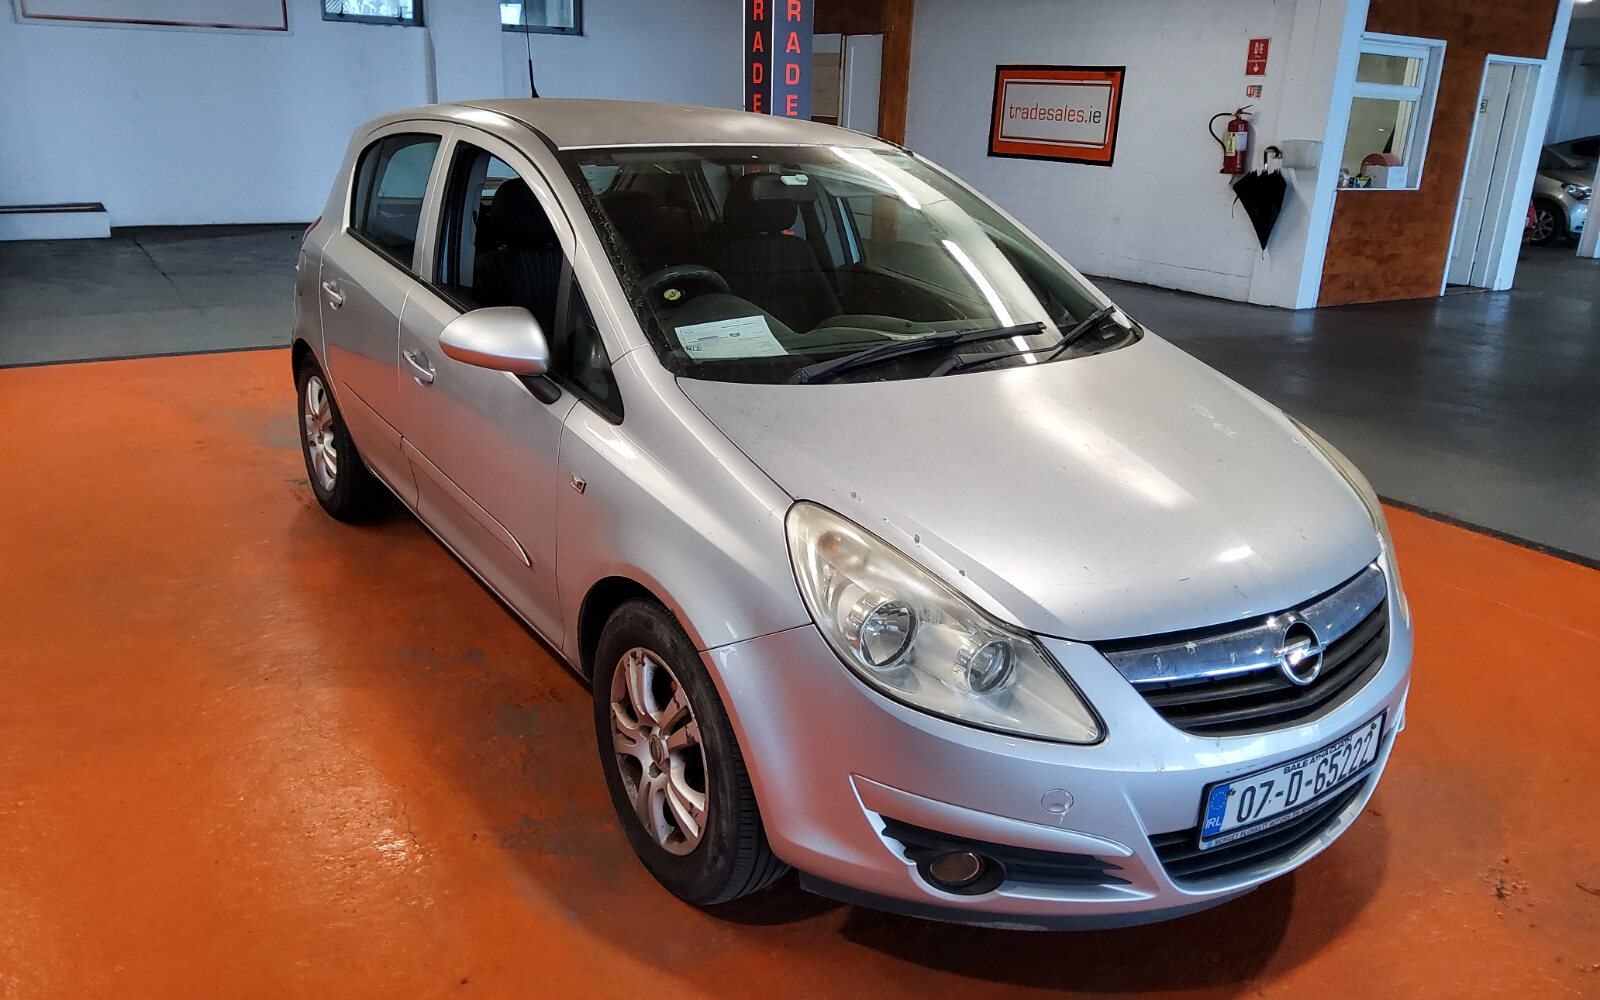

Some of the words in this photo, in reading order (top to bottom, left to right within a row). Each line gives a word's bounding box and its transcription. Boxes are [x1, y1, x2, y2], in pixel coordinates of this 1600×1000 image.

[1008, 102, 1102, 124] tradesales.ie
[1236, 730, 1373, 823] 07-D-65222
[1283, 760, 1308, 775] BAILE
[1205, 816, 1221, 830] IRL
